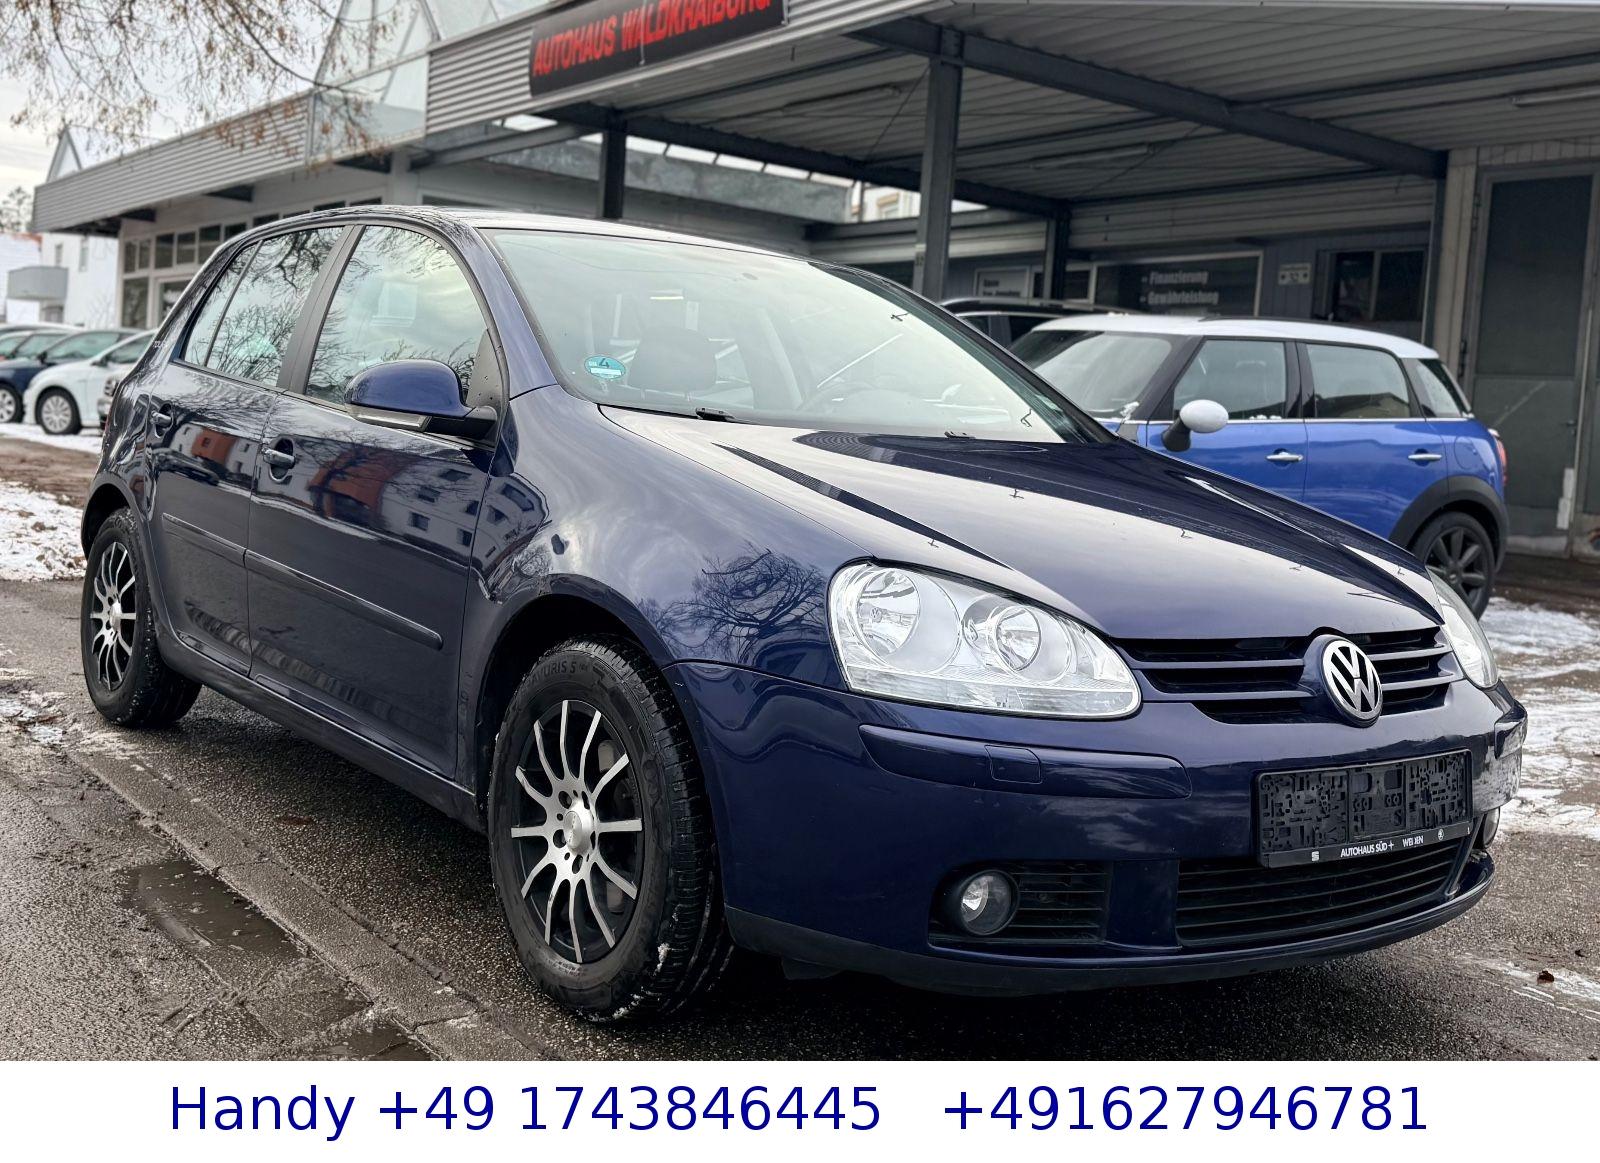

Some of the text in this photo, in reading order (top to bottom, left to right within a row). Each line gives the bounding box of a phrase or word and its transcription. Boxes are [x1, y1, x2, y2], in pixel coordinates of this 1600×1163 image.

[532, 0, 771, 77] AUTOHAUS WALDKRAIB
[1340, 844, 1375, 858] AUTOHAUS
